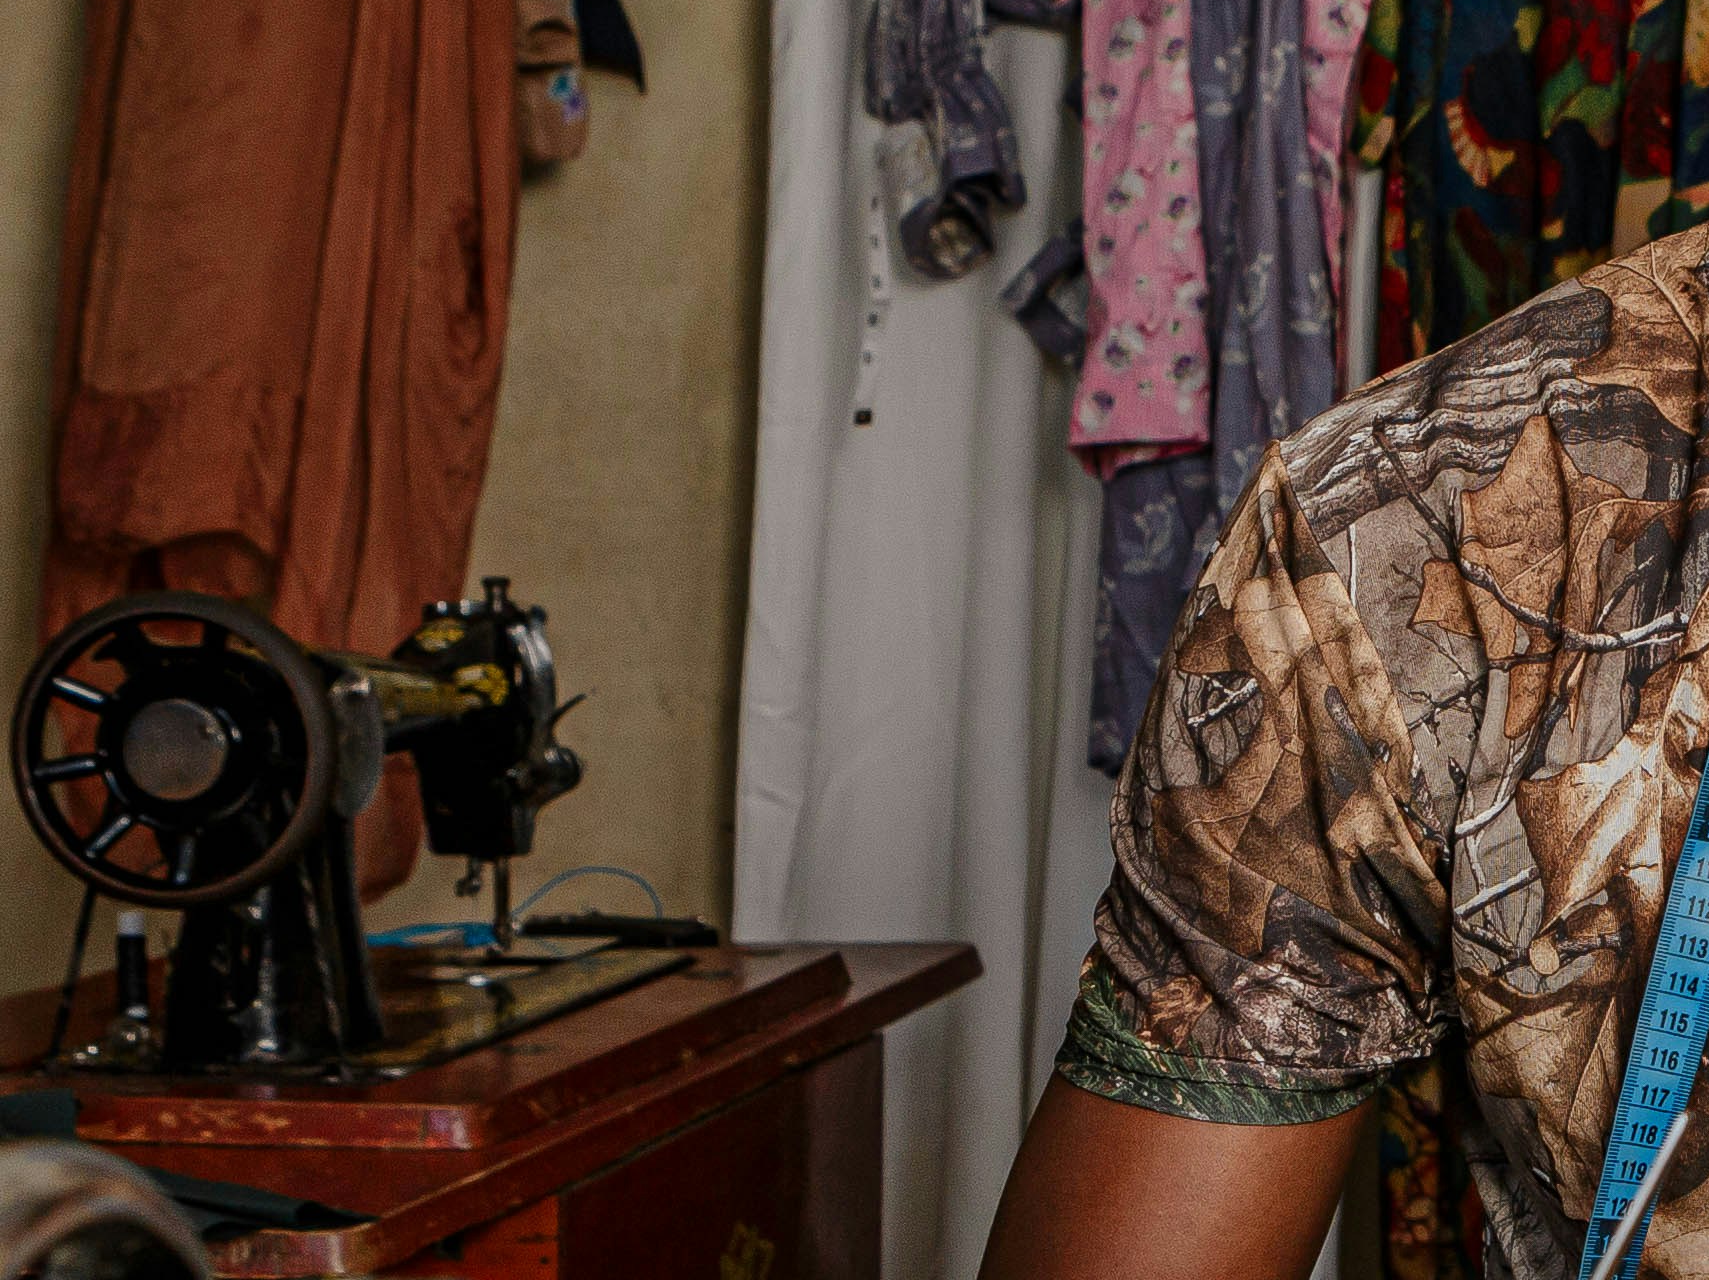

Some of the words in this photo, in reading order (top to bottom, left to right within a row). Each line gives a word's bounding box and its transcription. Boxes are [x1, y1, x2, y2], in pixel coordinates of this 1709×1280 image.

[1678, 933, 1709, 959] 113
[1669, 971, 1700, 996] 114
[1659, 1008, 1690, 1034] 115
[1650, 1046, 1680, 1071] 116
[1640, 1084, 1670, 1108] 117
[1630, 1122, 1659, 1145] 118
[1620, 1159, 1648, 1182] 119
